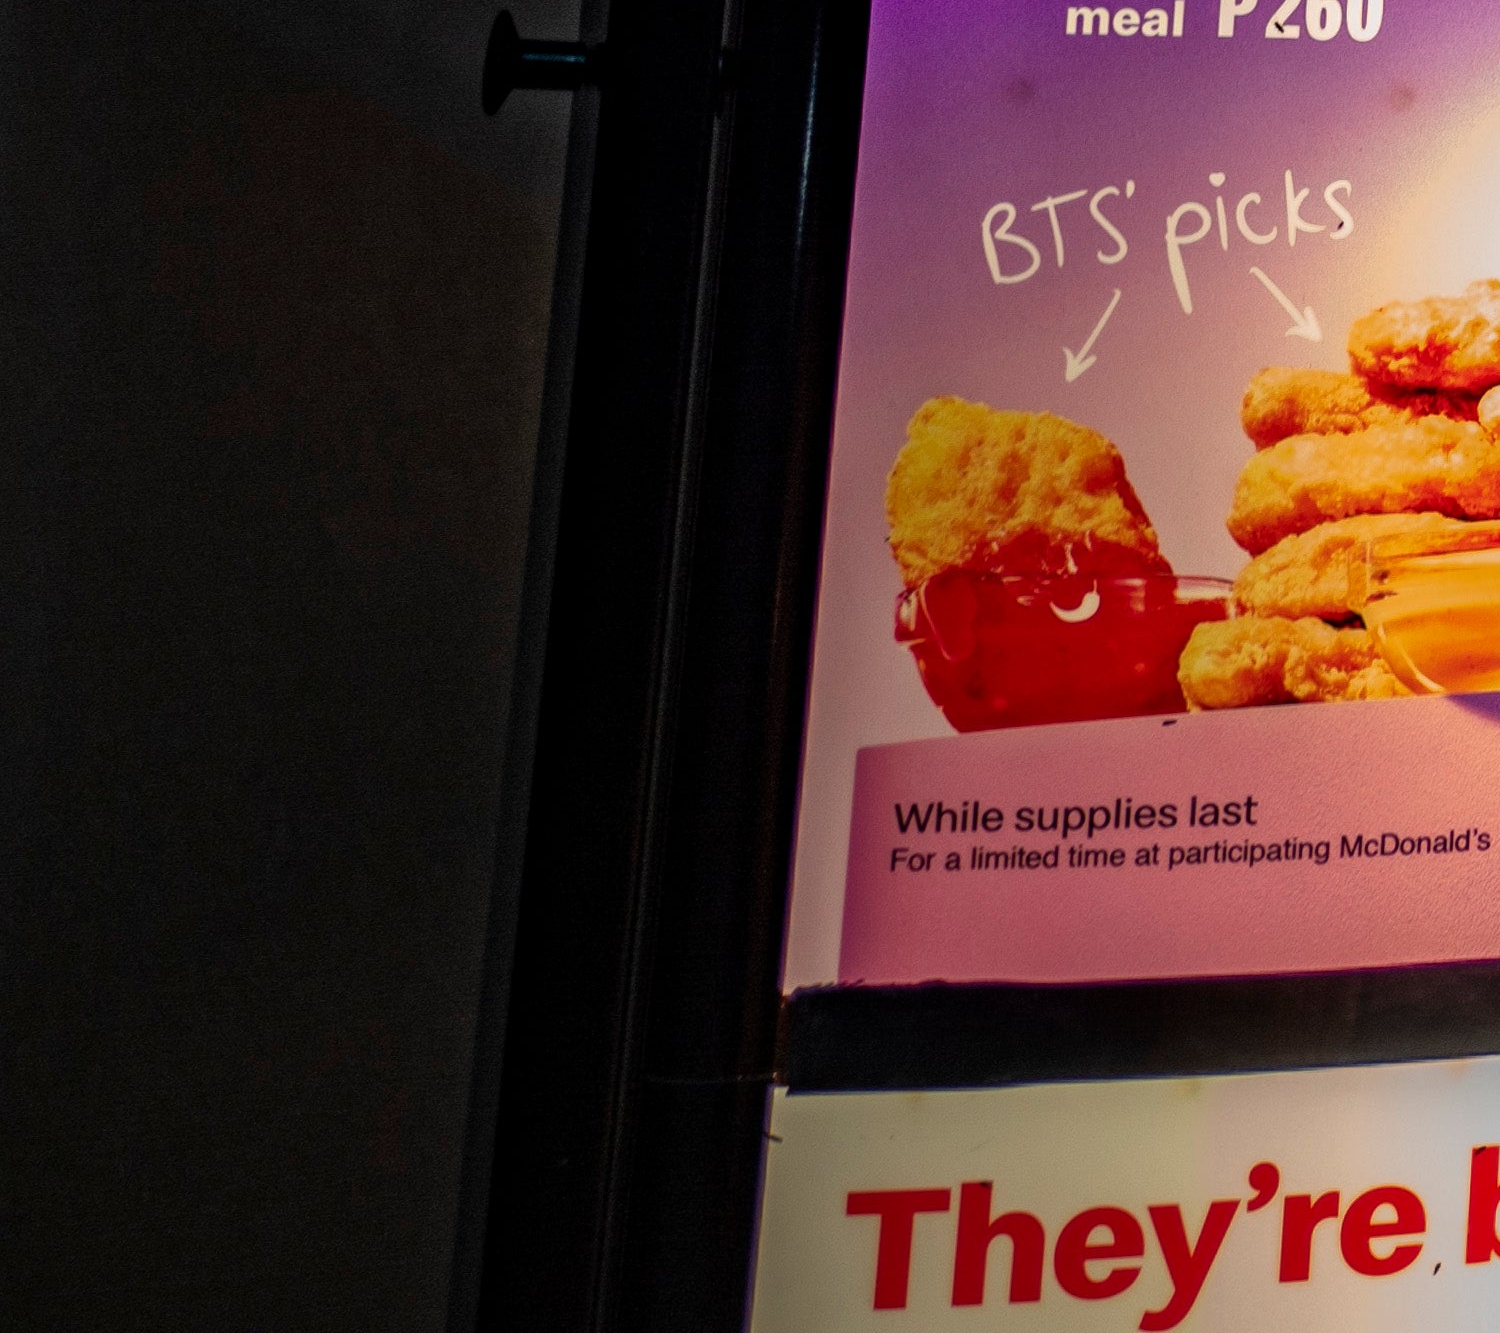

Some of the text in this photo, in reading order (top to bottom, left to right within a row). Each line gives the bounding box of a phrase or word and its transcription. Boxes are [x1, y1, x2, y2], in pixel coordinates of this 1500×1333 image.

[1065, 0, 1186, 40] meal
[981, 169, 1355, 316] BTS' picks
[893, 794, 1259, 839] While supplies last
[889, 828, 1492, 873] For a limited time at participating McDonald's
[845, 1160, 1428, 1333] They're
